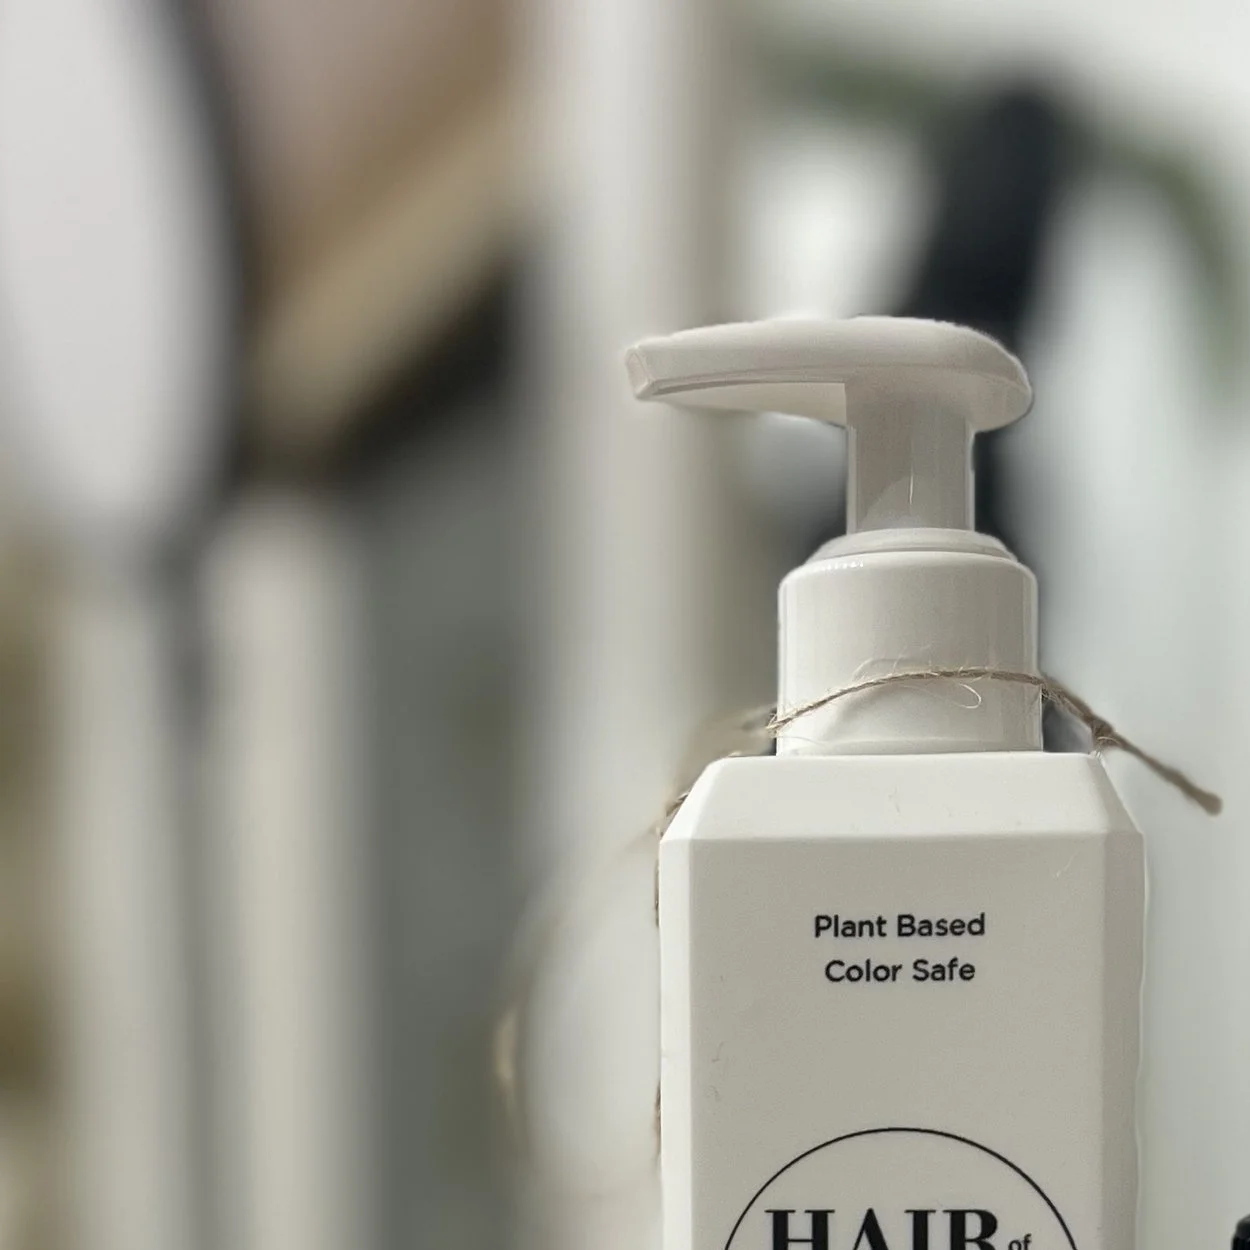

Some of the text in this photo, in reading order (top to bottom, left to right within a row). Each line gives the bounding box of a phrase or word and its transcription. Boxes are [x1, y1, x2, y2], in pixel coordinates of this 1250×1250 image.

[815, 912, 985, 938] Plant Based
[825, 957, 975, 982] Color Safe
